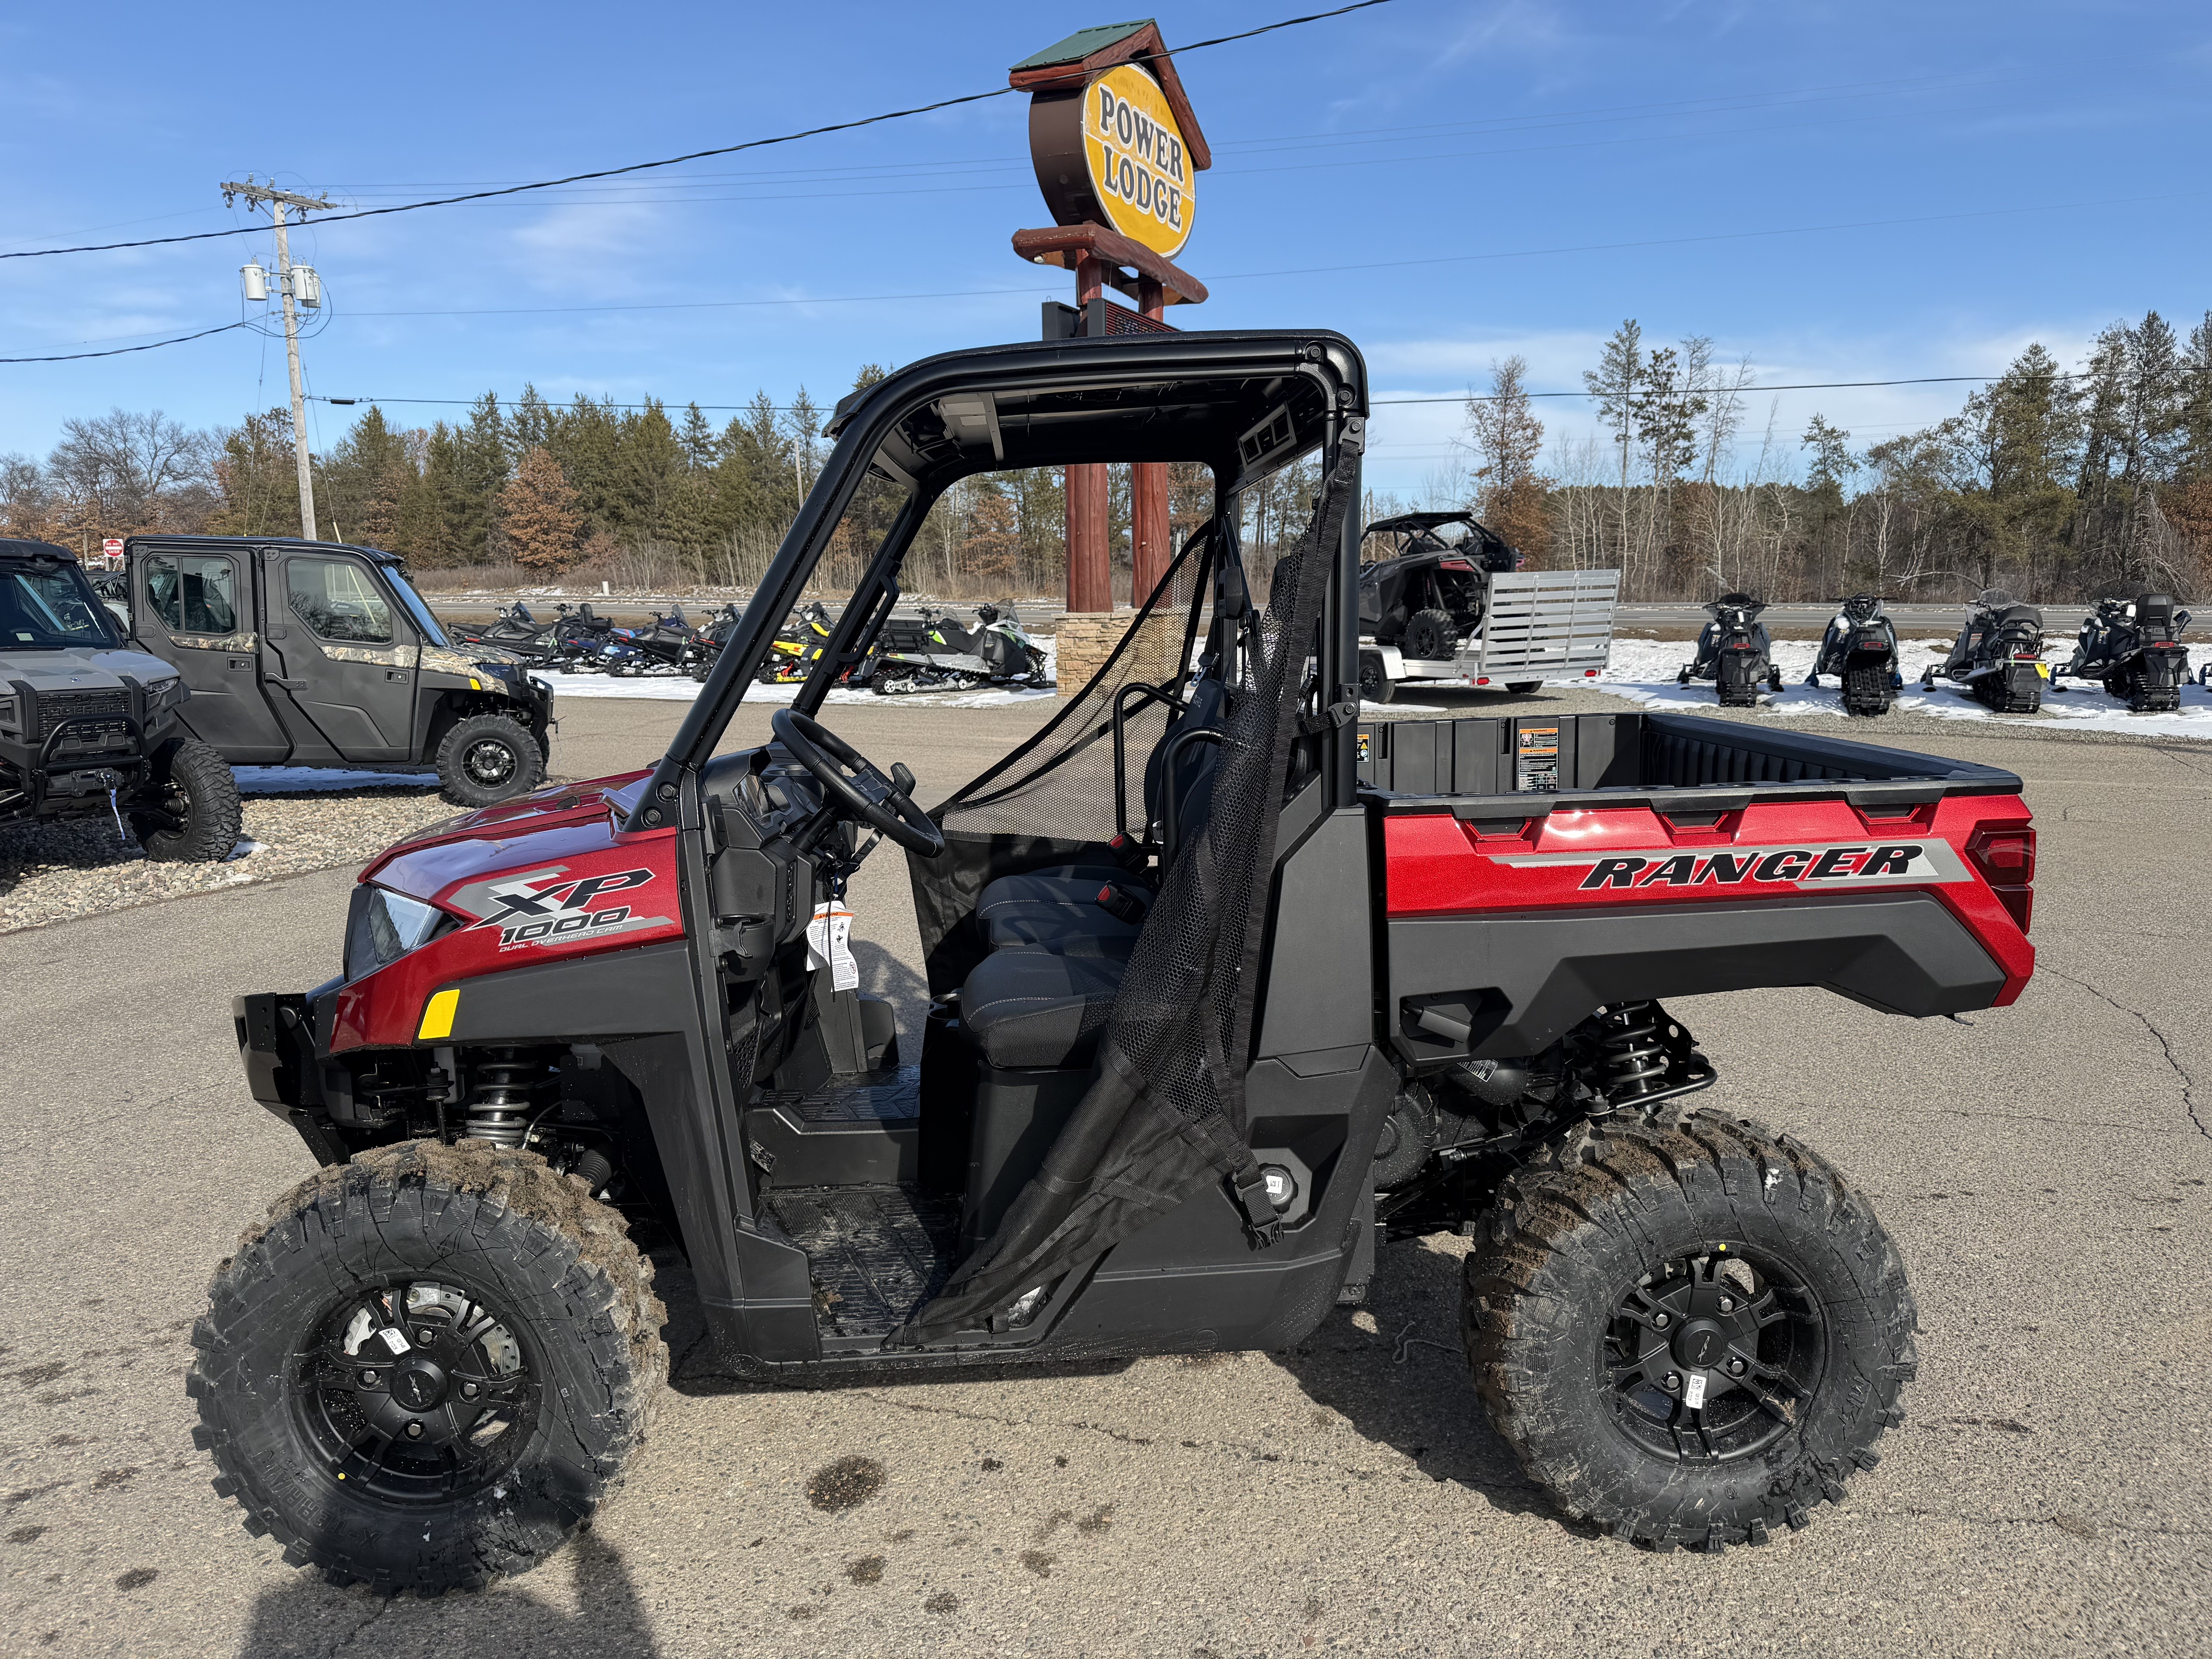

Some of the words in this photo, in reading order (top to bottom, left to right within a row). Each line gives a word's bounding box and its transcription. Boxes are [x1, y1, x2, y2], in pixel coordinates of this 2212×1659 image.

[1099, 86, 1184, 184] POWER
[1103, 144, 1182, 229] LODGE
[47, 703, 123, 716] POLARIS
[1577, 845, 1925, 890] RANGER
[461, 868, 656, 932] XP
[498, 905, 631, 946] 1000
[499, 943, 529, 952] DUAL
[531, 929, 596, 946] OVERHEAD
[596, 924, 623, 933] CAM
[251, 1448, 383, 1549] X-TERRAIN
